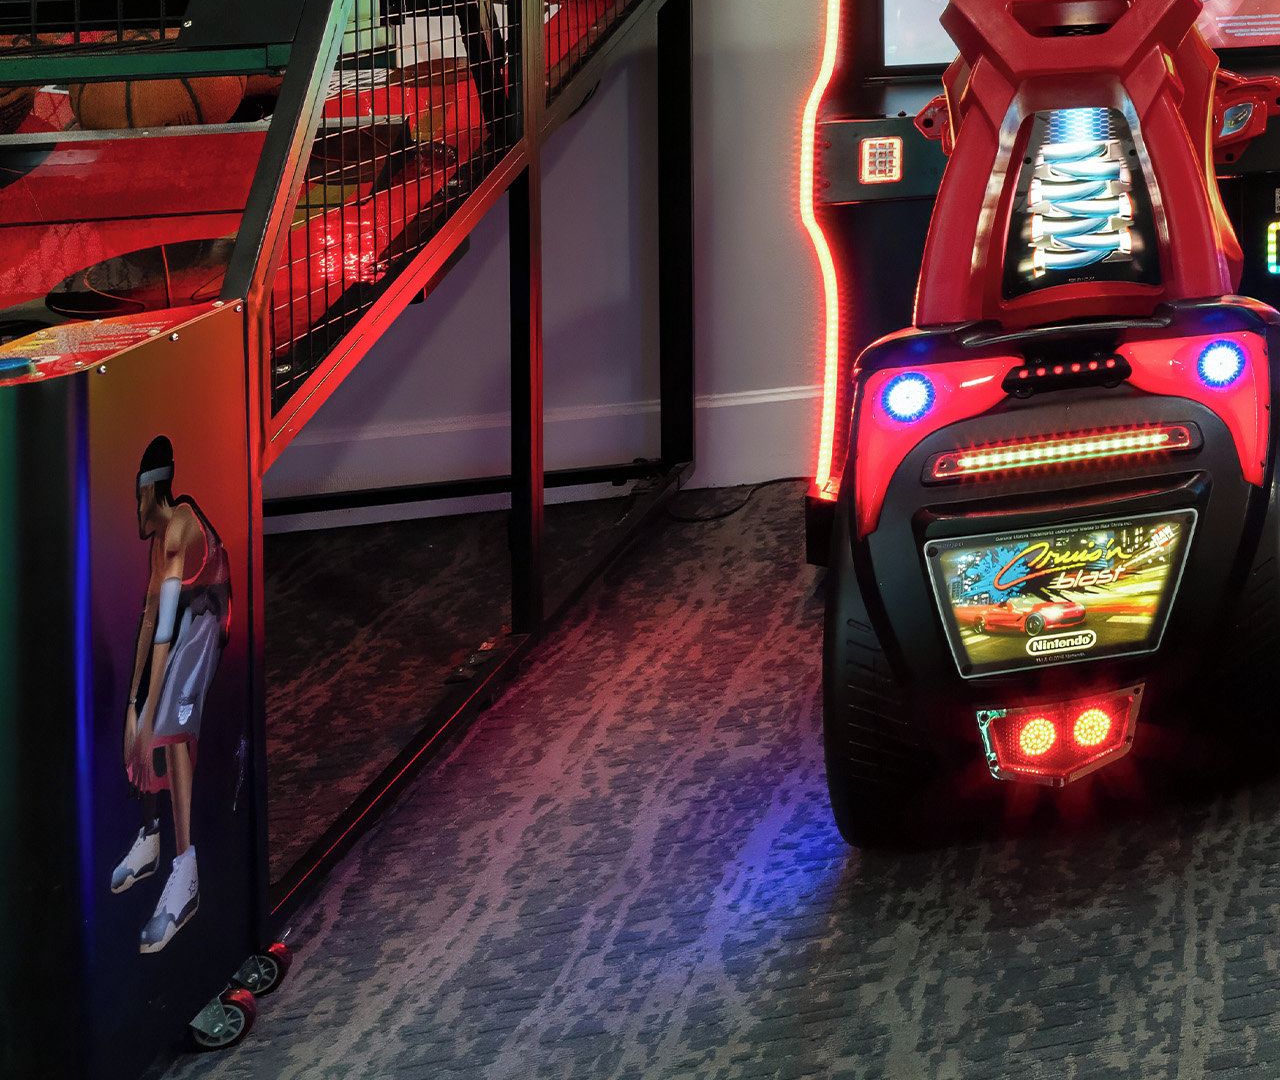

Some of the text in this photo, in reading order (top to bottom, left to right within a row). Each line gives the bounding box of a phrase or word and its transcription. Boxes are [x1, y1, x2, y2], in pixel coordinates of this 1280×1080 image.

[993, 538, 1132, 590] Cruis'n
[1050, 564, 1127, 589] blast
[1032, 634, 1091, 651] Nintendo
